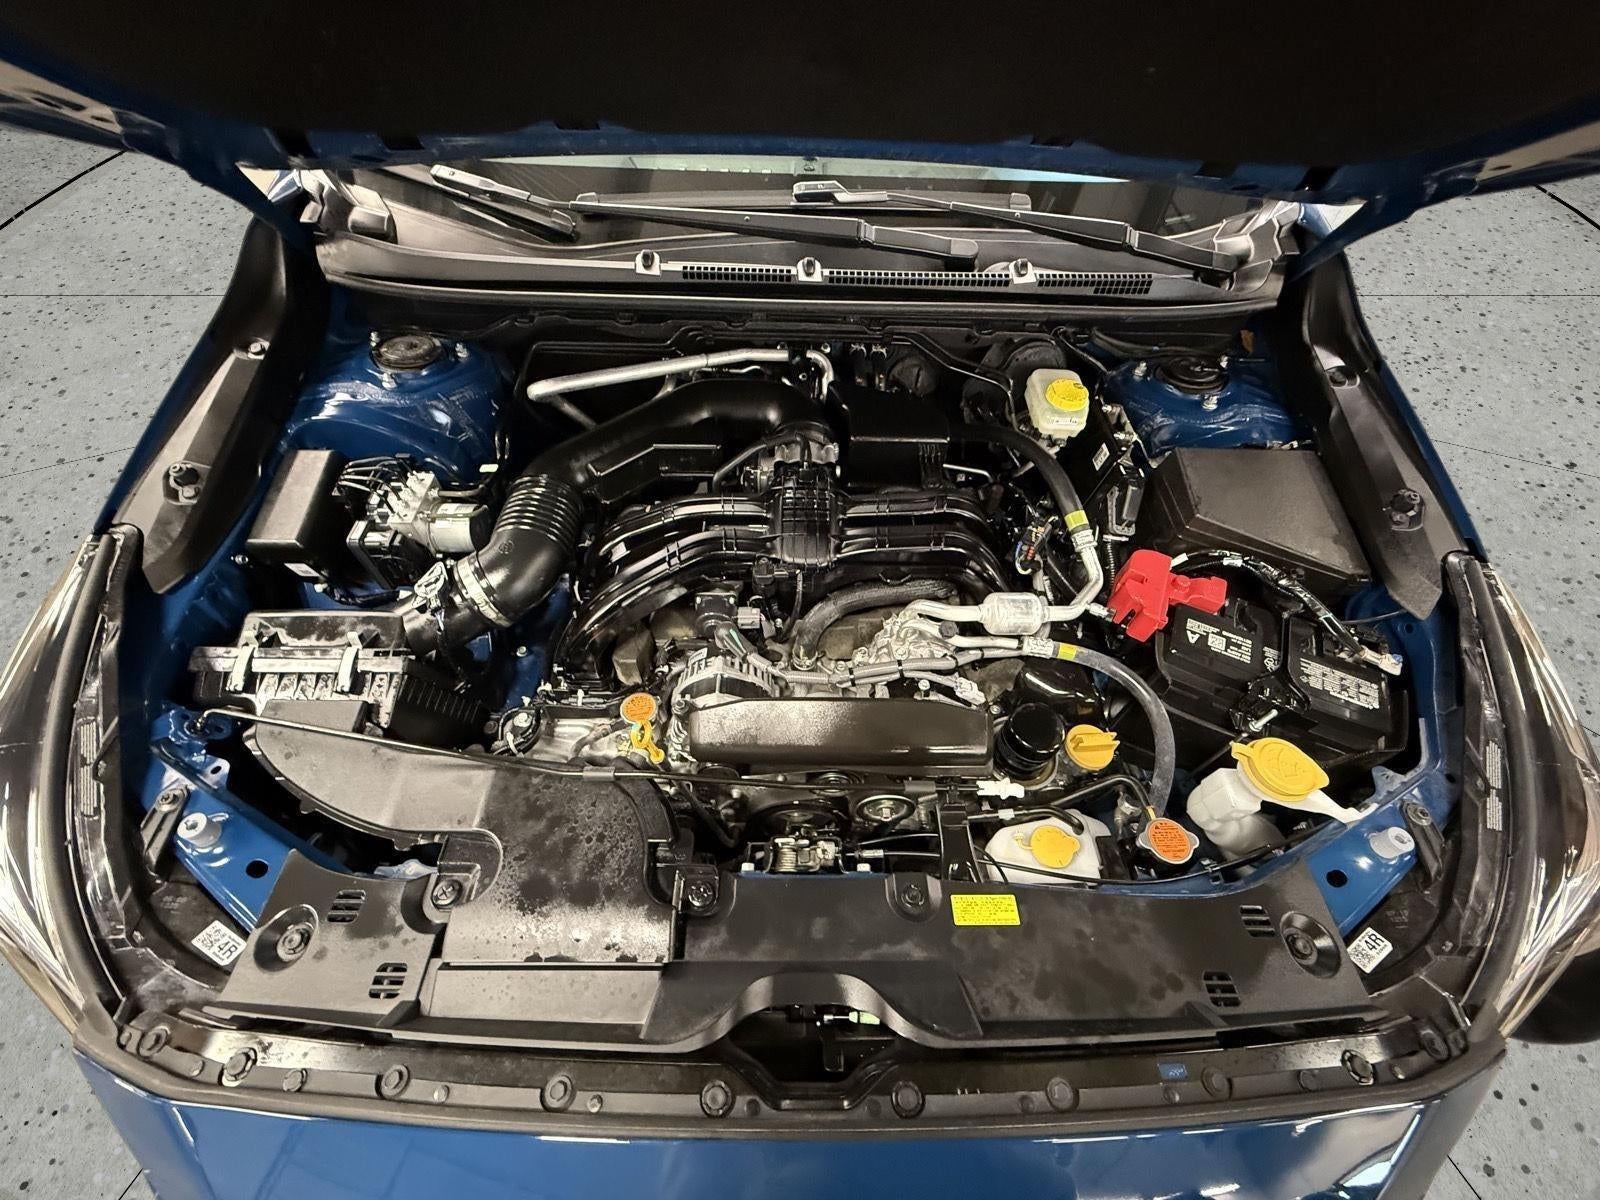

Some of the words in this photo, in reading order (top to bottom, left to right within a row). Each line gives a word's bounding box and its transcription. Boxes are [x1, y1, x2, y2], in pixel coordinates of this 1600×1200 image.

[1186, 630, 1201, 644] A
[218, 940, 238, 959] 4R
[1364, 933, 1385, 951] 4R
